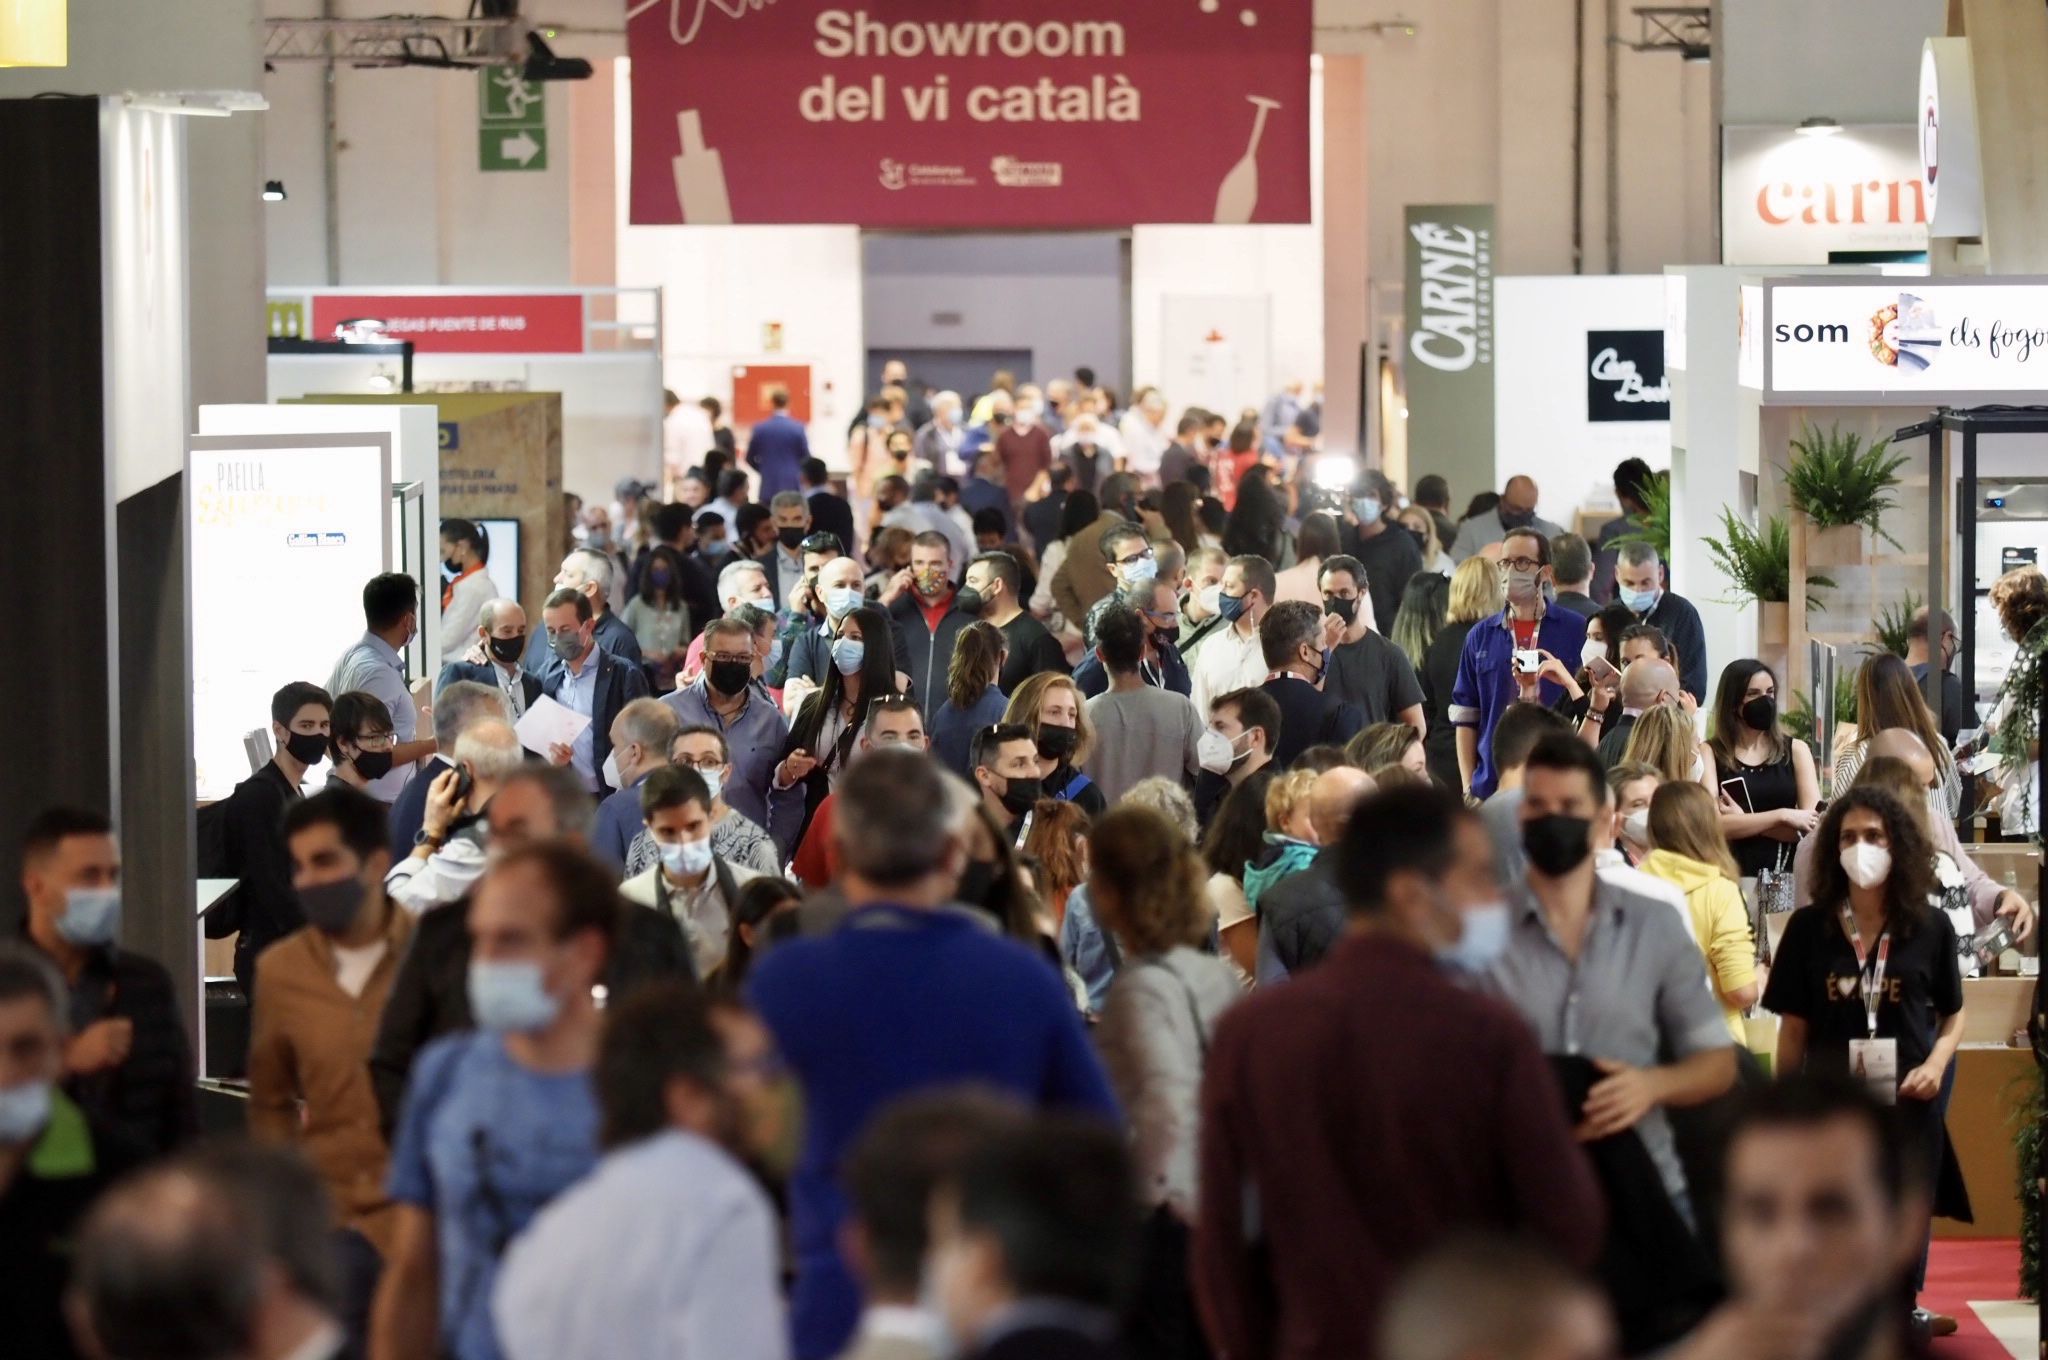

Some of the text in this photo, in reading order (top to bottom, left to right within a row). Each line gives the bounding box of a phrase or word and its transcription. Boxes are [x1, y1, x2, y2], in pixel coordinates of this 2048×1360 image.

[814, 9, 1126, 58] Showroom
[799, 75, 1142, 122] del vi català
[1410, 222, 1477, 372] CARNÉ
[428, 316, 477, 332] PUENTE
[478, 316, 496, 331] DE
[1775, 323, 1848, 343] som
[1950, 317, 1980, 348] els
[1990, 319, 2048, 363] fogo
[217, 462, 266, 492] PAELLA
